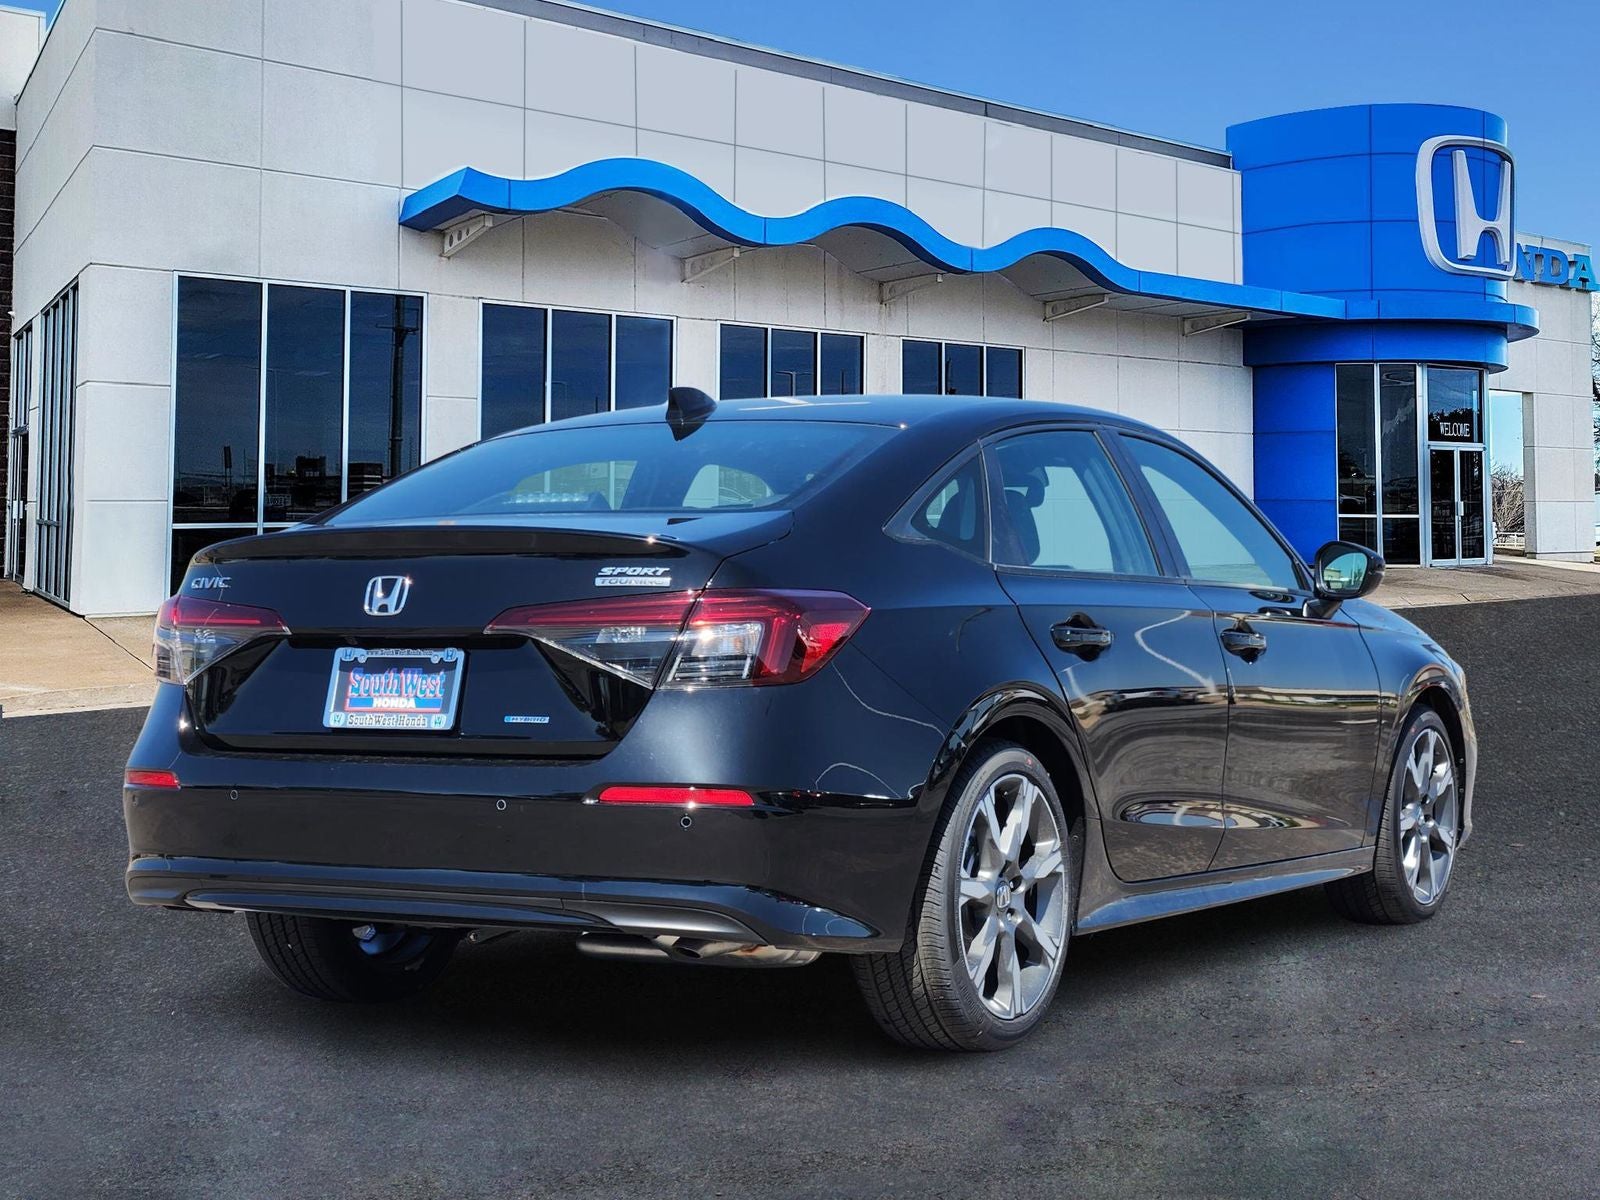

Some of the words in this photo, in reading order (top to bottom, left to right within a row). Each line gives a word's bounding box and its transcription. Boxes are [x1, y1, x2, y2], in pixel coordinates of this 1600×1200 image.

[1515, 242, 1600, 291] NDA
[1440, 421, 1470, 437] WELCOME
[598, 566, 671, 576] SPORT
[191, 576, 232, 589] CIVIC
[372, 698, 416, 708] HONDA
[398, 715, 427, 727] Honda
